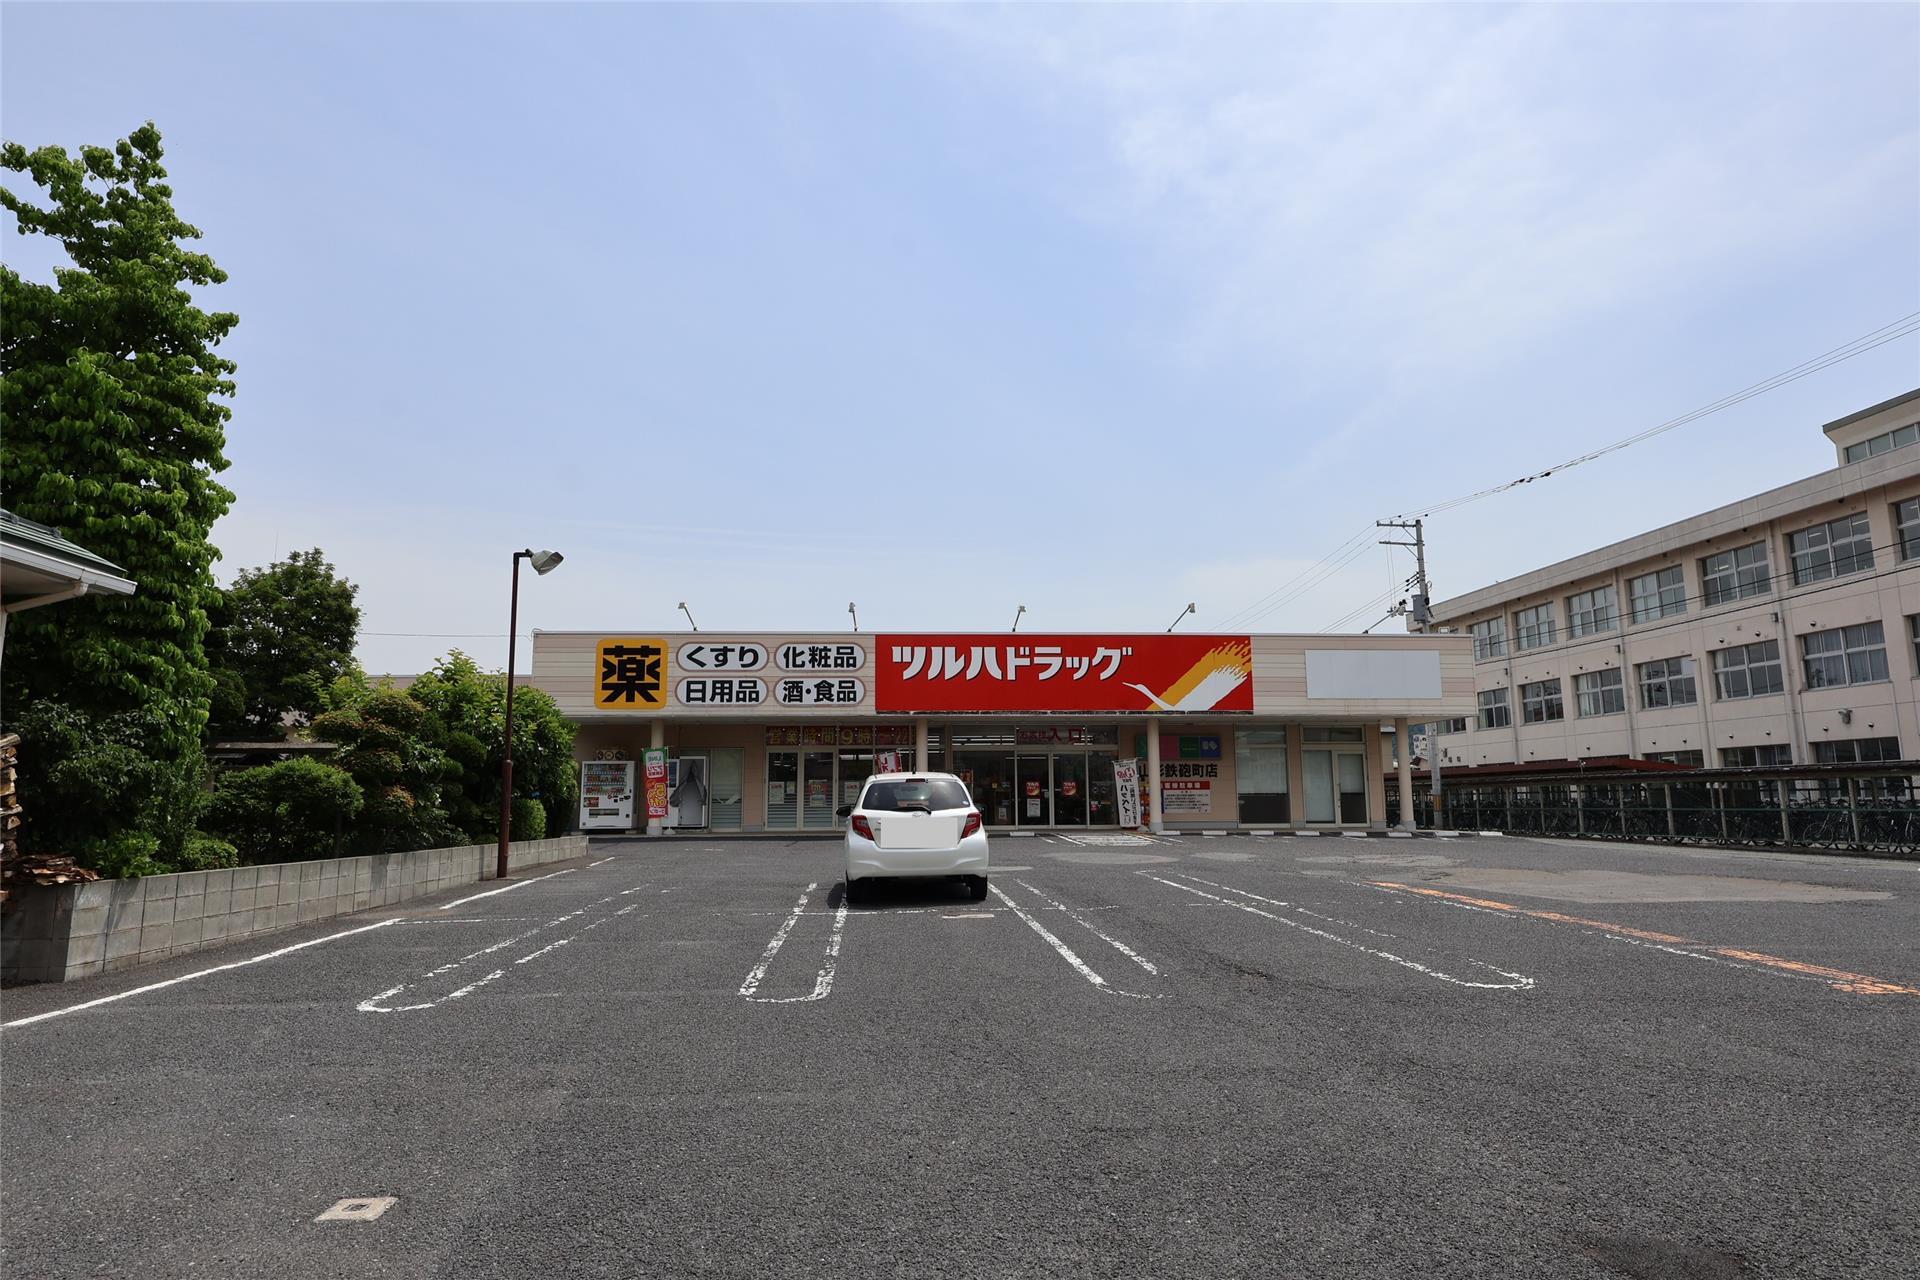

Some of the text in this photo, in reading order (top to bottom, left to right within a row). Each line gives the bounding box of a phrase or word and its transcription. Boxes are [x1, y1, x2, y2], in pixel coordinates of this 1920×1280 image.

[686, 645, 760, 668] くすり
[783, 645, 857, 669] 化粧品
[892, 646, 1134, 681] ツルハドラッグ
[602, 645, 661, 703] 薬
[685, 680, 760, 703] 日用品
[783, 680, 857, 703] 酒・食品
[1138, 763, 1218, 778] 山鉄砲町店
